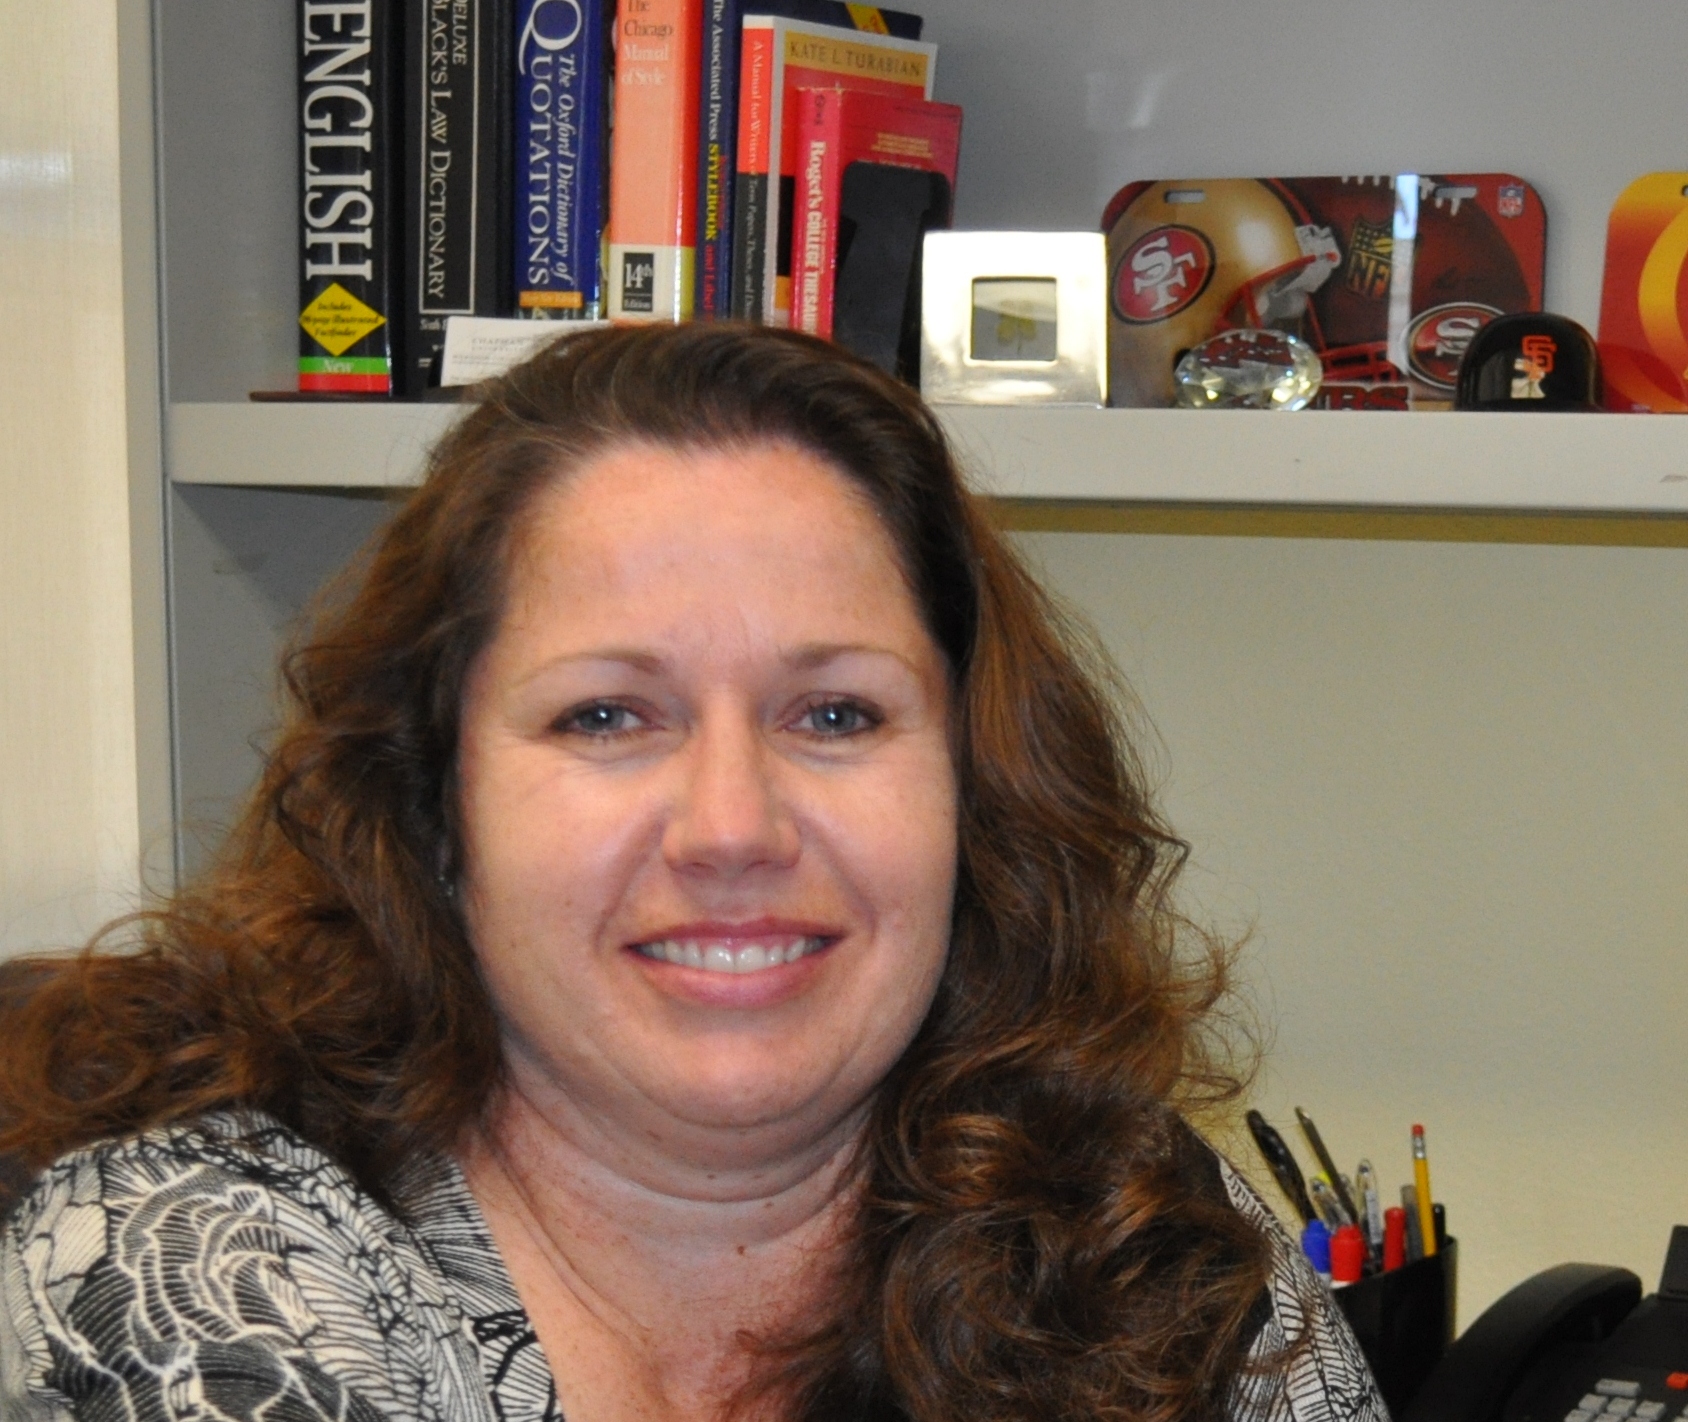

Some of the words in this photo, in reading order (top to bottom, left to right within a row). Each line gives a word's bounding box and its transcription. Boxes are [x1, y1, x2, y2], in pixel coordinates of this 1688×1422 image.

[624, 20, 673, 39] Chicago
[624, 43, 670, 60] Manual
[753, 41, 764, 51] A
[558, 54, 577, 88] The
[709, 24, 724, 101] Associated
[752, 54, 764, 100] Manual
[791, 41, 827, 62] KATE
[846, 49, 921, 78] TURABIAN
[431, 90, 452, 144] LAW
[553, 94, 576, 158] Oxford
[708, 103, 722, 141] Press
[304, 0, 373, 281] ENGLISH
[518, 0, 582, 285] QUOTATIONS
[749, 119, 763, 164] Writers
[705, 143, 721, 240] STYLEBOOK
[805, 141, 827, 209] Roget's
[428, 151, 451, 299] DICTIONARY
[551, 162, 574, 258] Dictionary
[805, 210, 823, 268] COLLEGE
[550, 262, 576, 286] of
[625, 262, 654, 289] 14th
[323, 358, 354, 373] New
